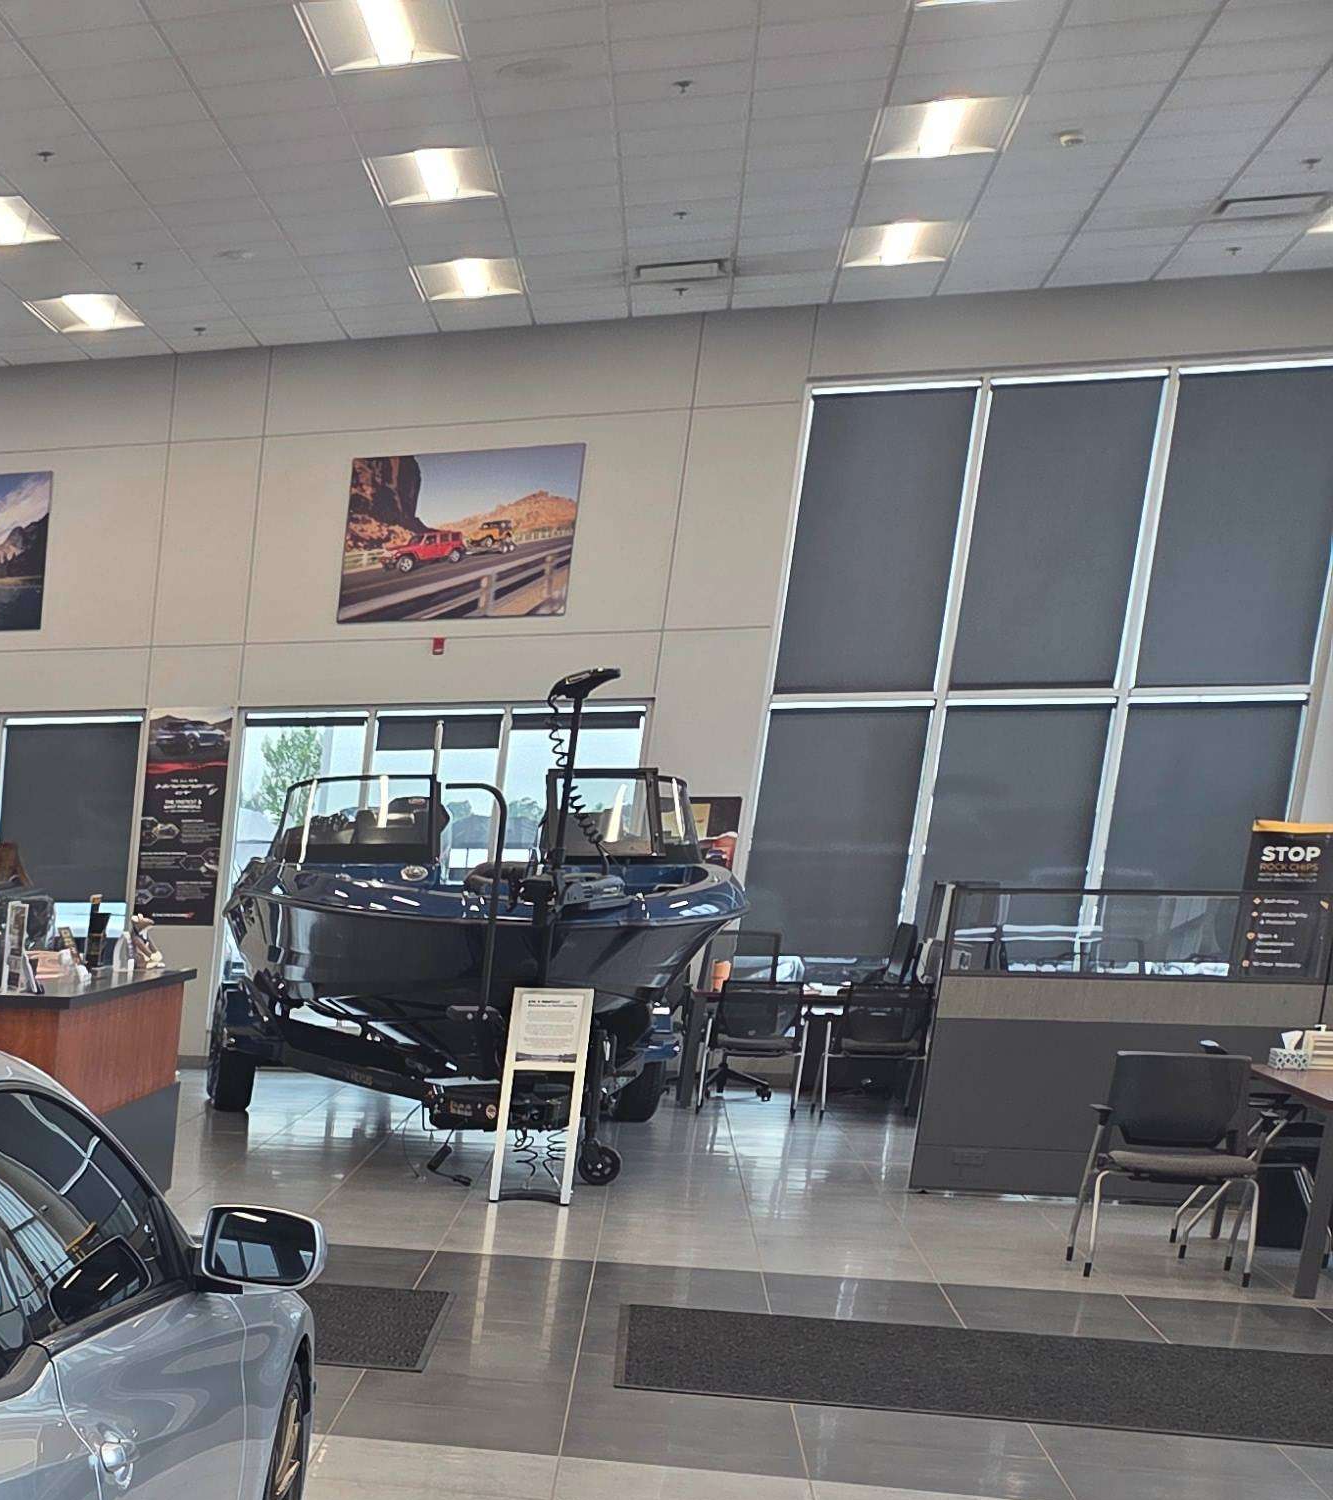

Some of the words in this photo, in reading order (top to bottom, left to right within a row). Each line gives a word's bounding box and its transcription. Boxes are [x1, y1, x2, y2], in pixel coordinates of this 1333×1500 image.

[1260, 845, 1321, 862] STOP
[1259, 863, 1287, 872] ROCK
[1289, 863, 1319, 872] CHIPS
